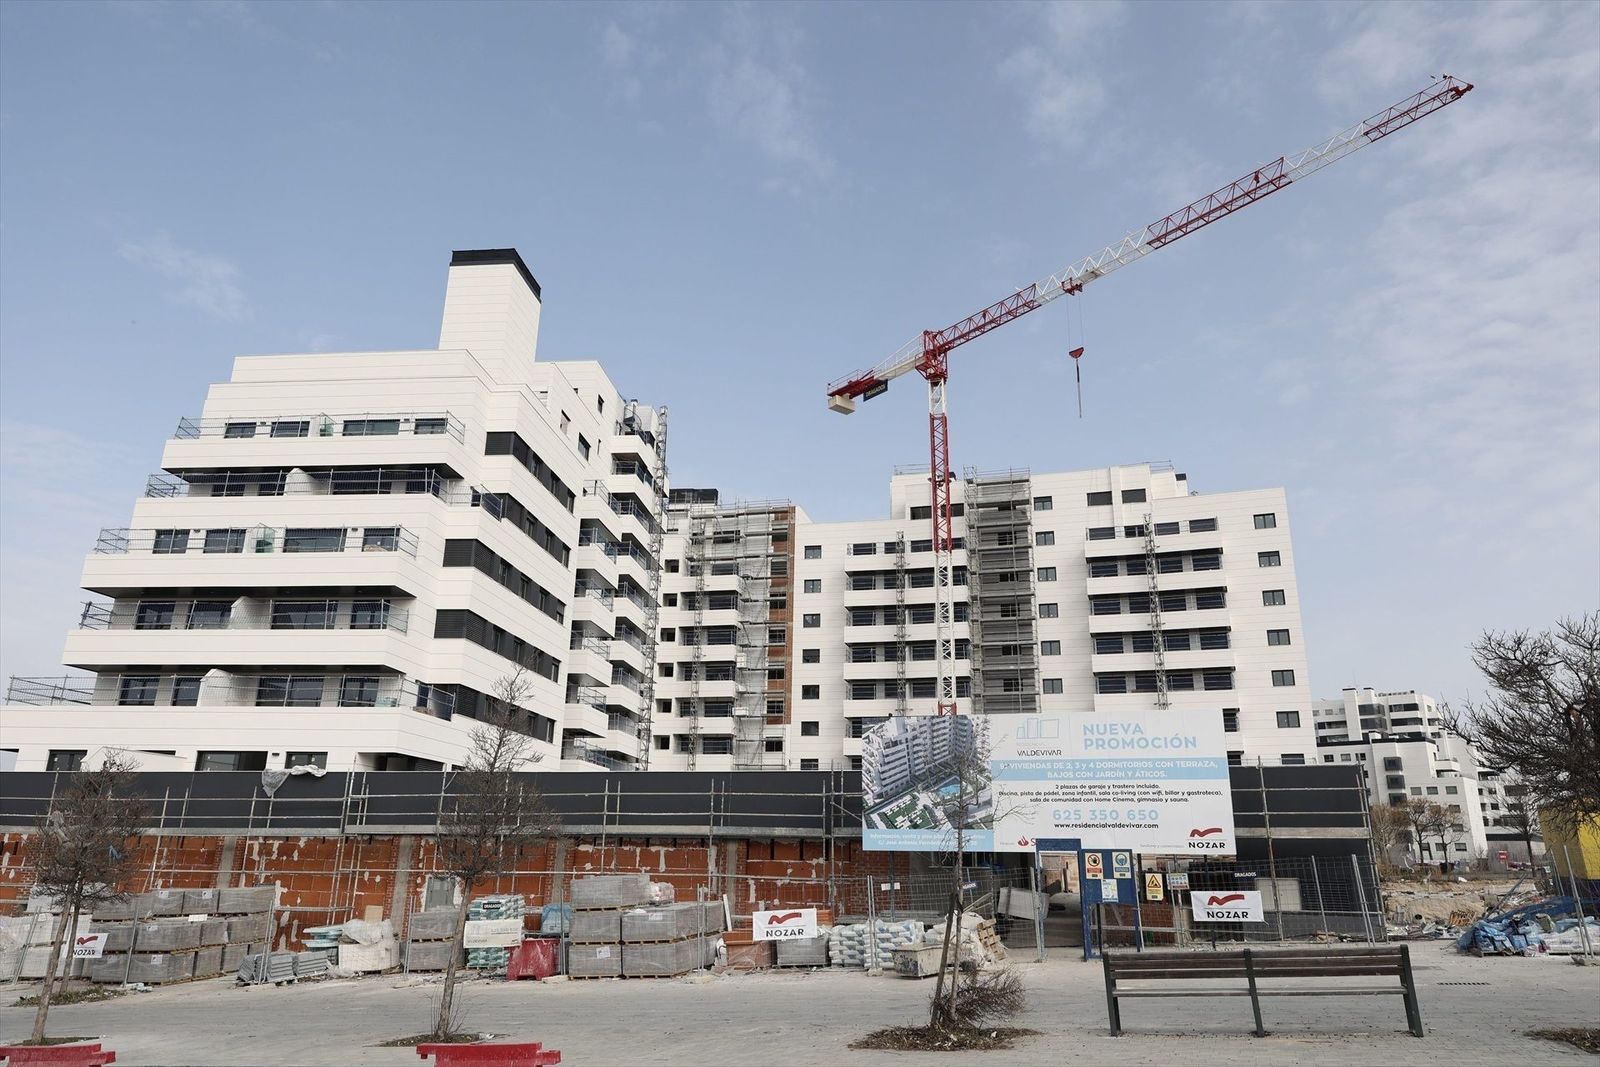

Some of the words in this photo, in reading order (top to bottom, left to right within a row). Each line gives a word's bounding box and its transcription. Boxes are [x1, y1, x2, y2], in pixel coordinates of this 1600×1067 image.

[1083, 723, 1144, 735] NUEVA
[1084, 733, 1197, 750] PROMOCIÓN
[1066, 762, 1073, 770] 2,
[1176, 760, 1218, 768] TERRAZA,
[1095, 770, 1125, 778] JARDÍN
[1135, 769, 1167, 777] ÁTICOS.
[1053, 809, 1082, 820] 625
[1089, 809, 1119, 820] 350
[1127, 809, 1159, 820] 650
[1206, 911, 1249, 919] NOZAR
[766, 929, 804, 937] NOZAR
